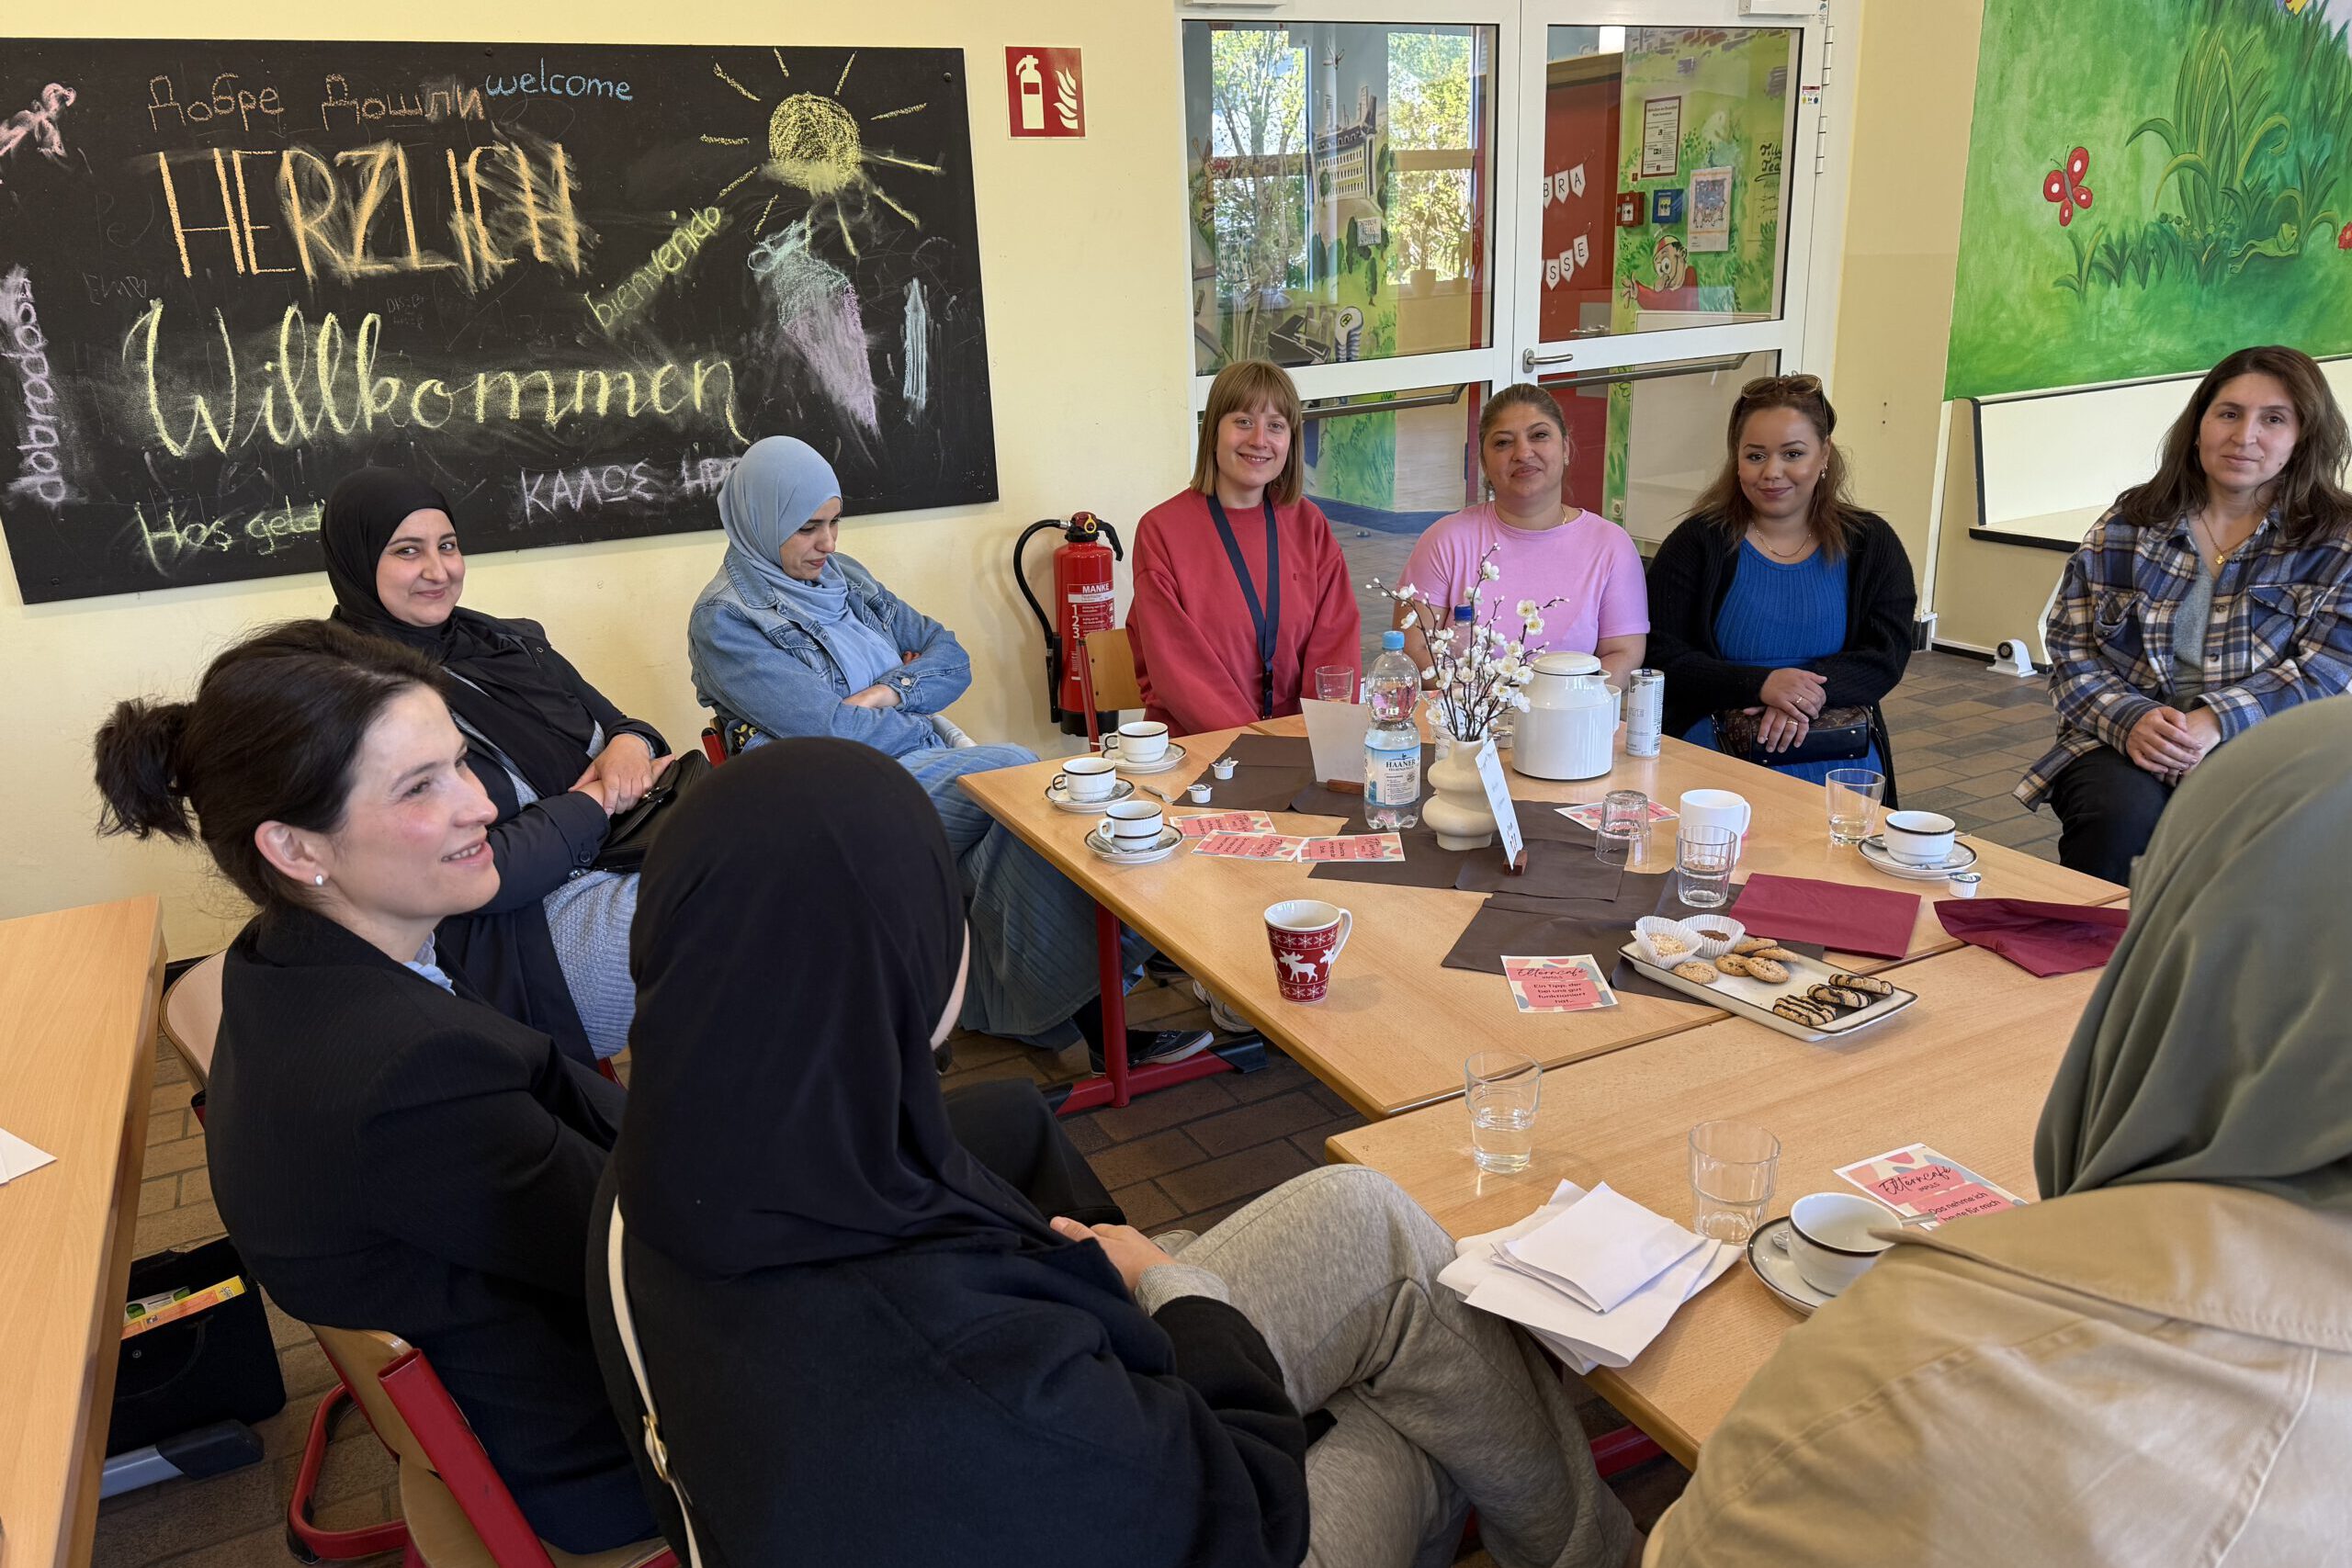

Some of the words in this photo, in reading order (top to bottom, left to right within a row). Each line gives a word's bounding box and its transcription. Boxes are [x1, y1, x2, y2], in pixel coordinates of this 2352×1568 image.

[485, 57, 633, 101] welcome
[147, 73, 285, 132] Добре
[322, 73, 486, 132] Дошли
[582, 205, 722, 329] bienvenido
[120, 296, 751, 457] Willkommen
[245, 494, 326, 556] geld
[1082, 582, 1109, 593] MANKE
[1071, 604, 1077, 615] 1
[1071, 615, 1079, 626] 2
[1072, 627, 1080, 638] 3
[1385, 759, 1416, 768] HAANER
[1516, 967, 1588, 977] Elterncafé
[1878, 1166, 1951, 1196] Elterncafé
[1946, 1196, 1976, 1210] nehme
[1973, 1191, 1989, 1200] ich
[1965, 1205, 1980, 1214] für
[1979, 1199, 2002, 1211] mich
